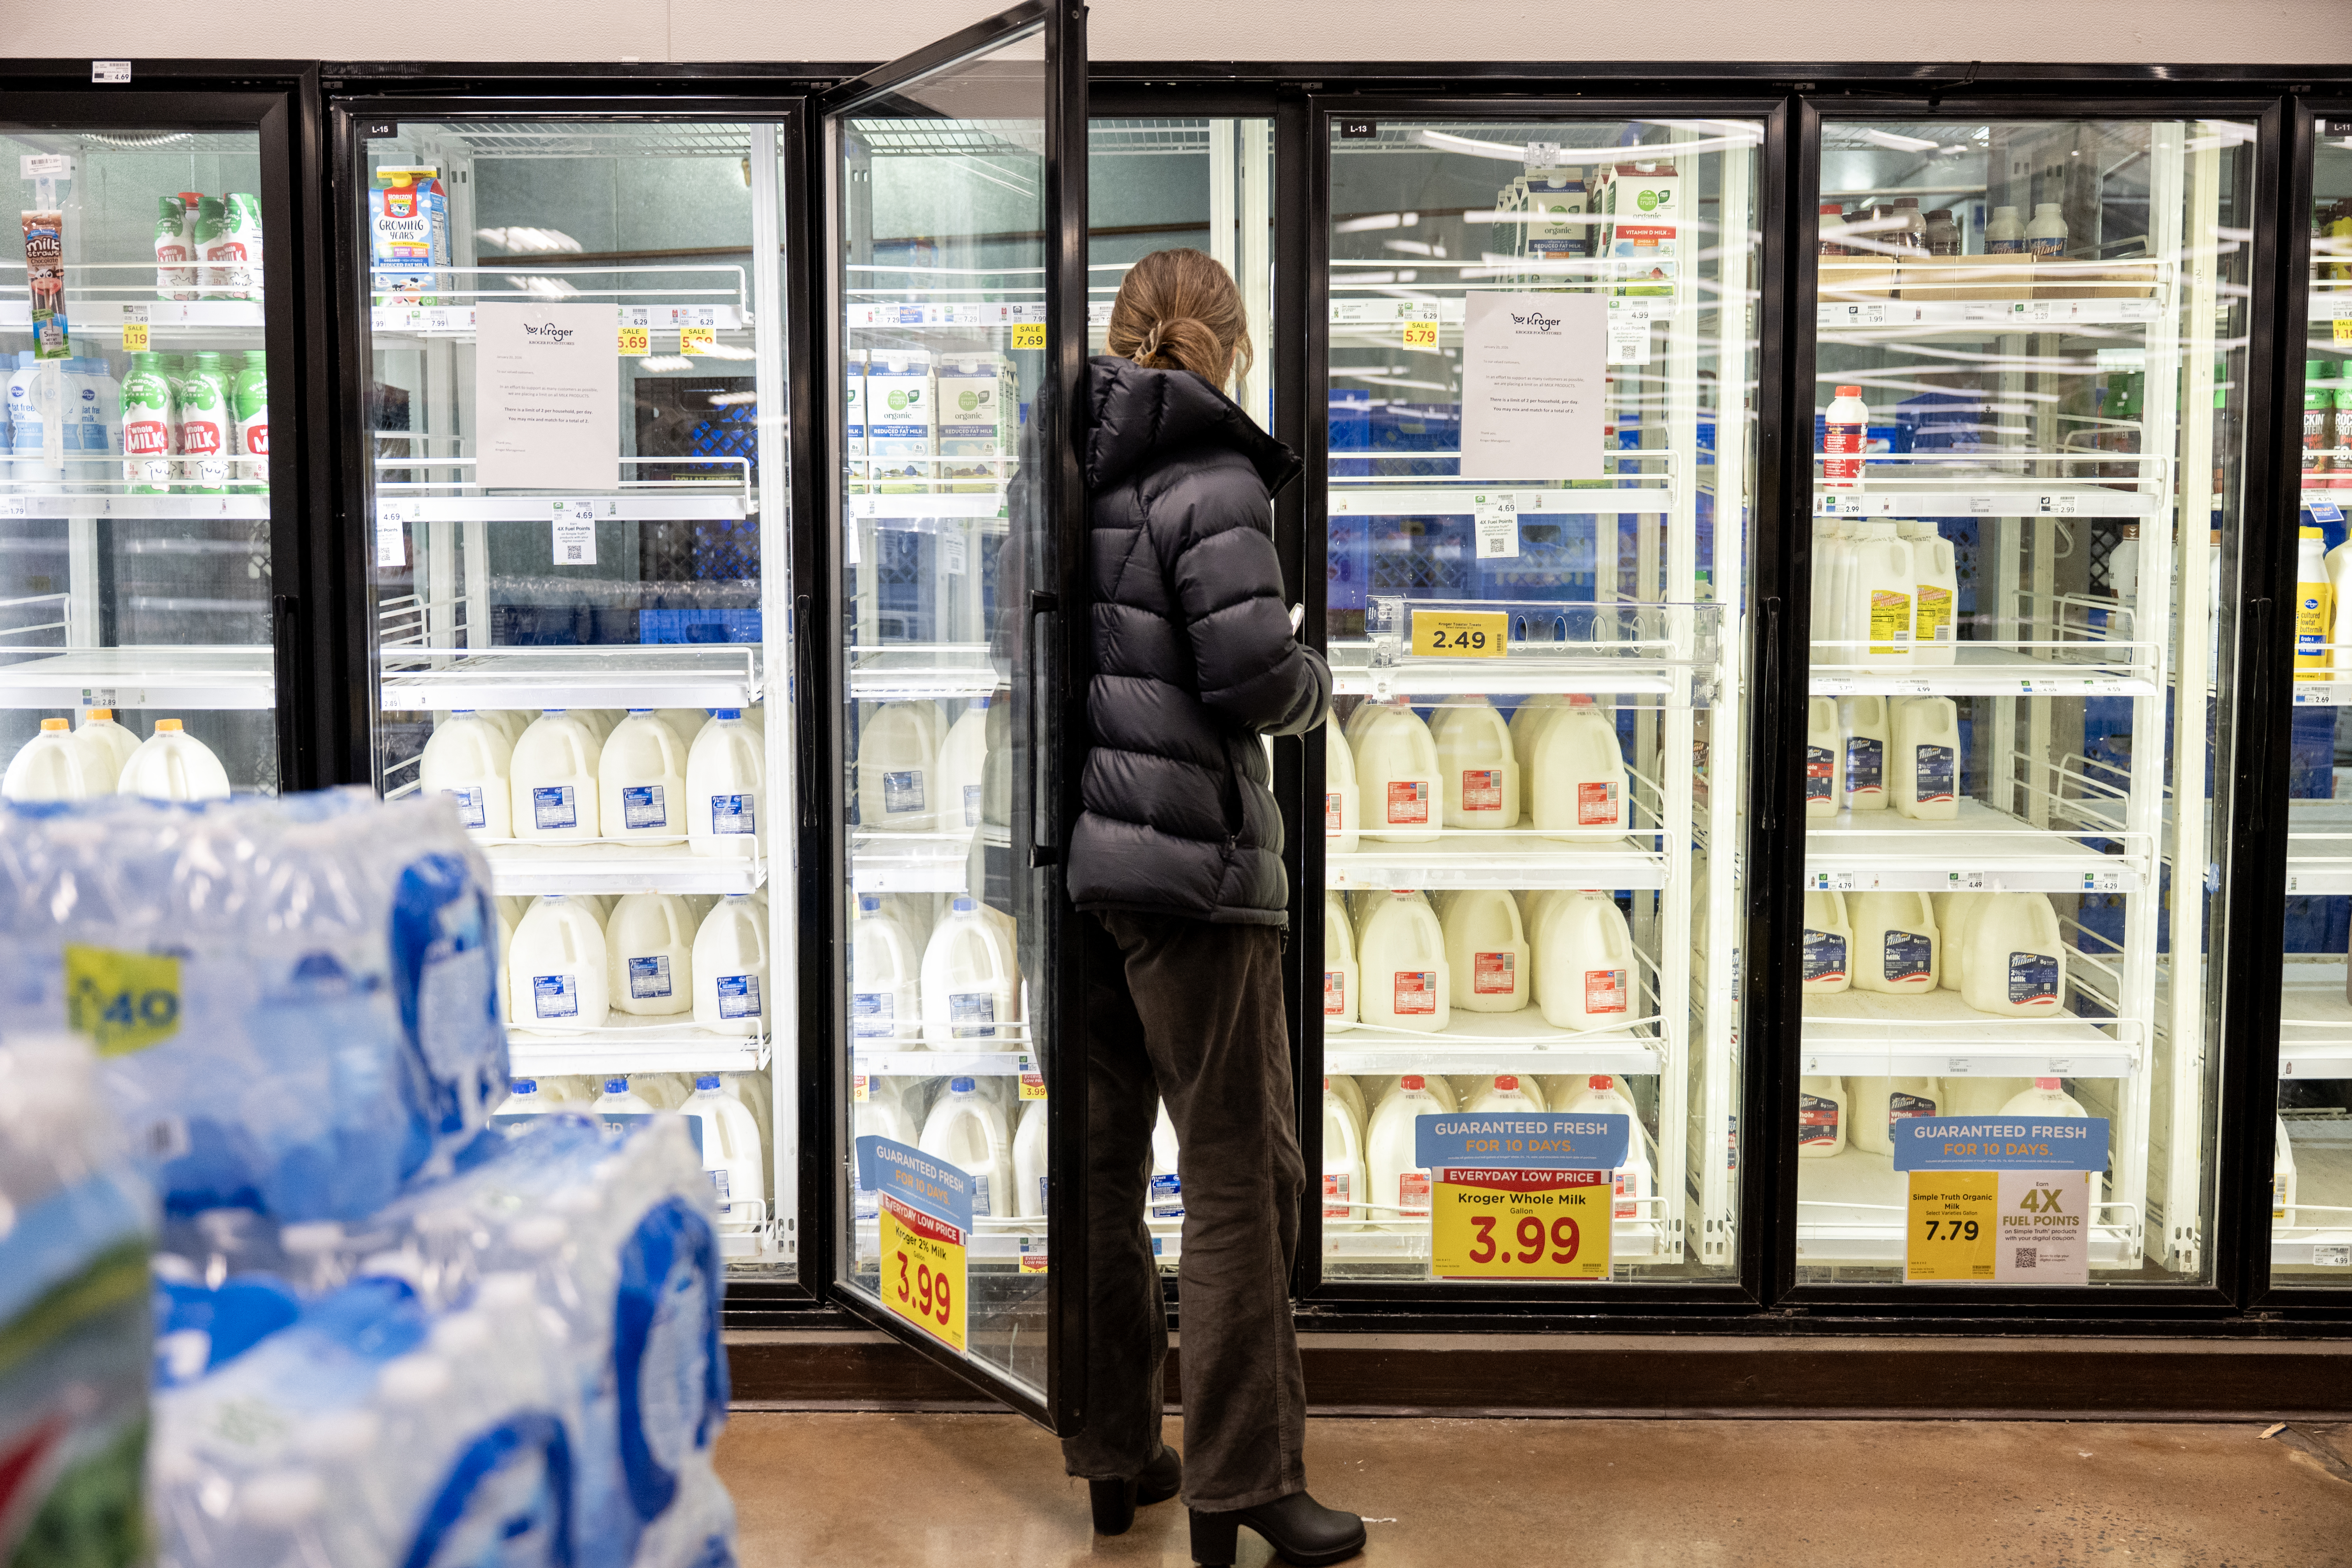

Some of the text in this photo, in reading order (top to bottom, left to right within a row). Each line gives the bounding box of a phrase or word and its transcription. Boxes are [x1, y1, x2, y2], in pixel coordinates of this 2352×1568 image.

[380, 219, 424, 230] GROWING
[390, 231, 414, 240] YEARS
[26, 238, 59, 251] milk
[1527, 312, 1561, 331] Kroger
[540, 323, 573, 341] Kroger
[1406, 331, 1435, 342] 5.79
[124, 334, 147, 344] 1.19
[618, 337, 647, 348] 5.69
[1017, 336, 1043, 345] 7.69
[131, 425, 153, 434] whole
[128, 431, 164, 450] MILK
[1433, 630, 1486, 649] 2.49
[1435, 1122, 1607, 1135] GUARANTEED FRESH
[1914, 1125, 2086, 1139] GUARANTEED FRESH
[1466, 1139, 1575, 1152] FOR 10 DAYS.
[1944, 1143, 2053, 1156] FOR 10 DAYS.
[876, 1145, 964, 1194] GUARANTEED FRESH
[1449, 1171, 1594, 1182] EVERYDAY LOW PRICE
[896, 1169, 914, 1188] FOR
[915, 1178, 924, 1193] 10
[927, 1183, 950, 1206] DAYS.
[1458, 1193, 1586, 1205] Kroger Whole Milk
[1913, 1194, 1938, 1202] Simple
[1962, 1194, 1993, 1202] Organic
[2020, 1189, 2063, 1213] 4X
[885, 1195, 916, 1222] EVERYDAY
[917, 1213, 934, 1230] LOW
[936, 1222, 957, 1241] PRICE
[2003, 1216, 2079, 1226] FUEL POINTS
[1926, 1220, 1979, 1241] 7.79
[896, 1226, 947, 1260] Kroger 2% Milk
[1469, 1216, 1580, 1264] 3.99
[914, 1251, 925, 1262] Gallon
[898, 1250, 950, 1325] 3.99
